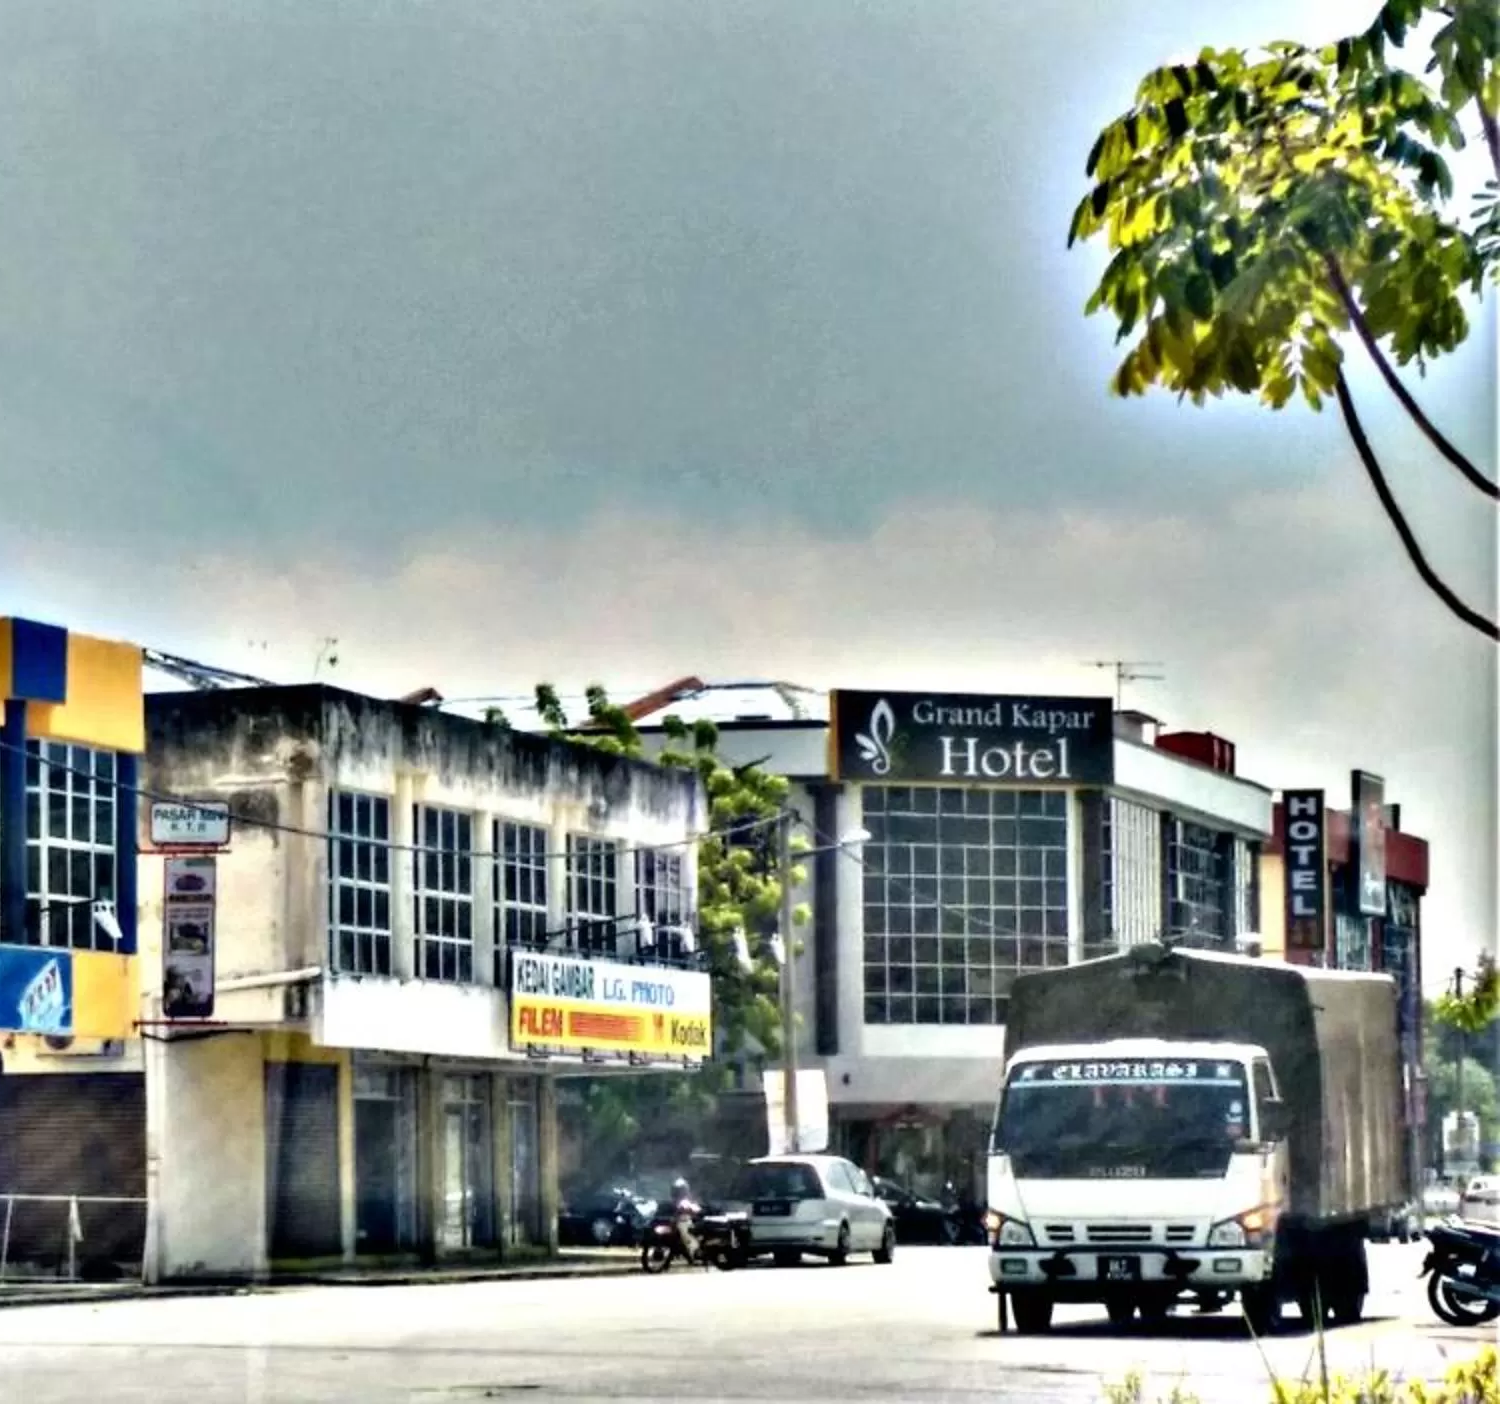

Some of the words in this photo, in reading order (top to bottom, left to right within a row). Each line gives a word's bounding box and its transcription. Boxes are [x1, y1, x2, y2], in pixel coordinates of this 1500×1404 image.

[912, 700, 1001, 727] Grand
[1011, 703, 1095, 734] Kapar
[939, 736, 1071, 778] Hotel
[1288, 797, 1317, 916] HOTEL
[517, 958, 549, 995] KEDAI
[552, 962, 595, 1000] GAMBAR
[631, 980, 675, 1004] PHOTO
[671, 1018, 706, 1046] Kodak
